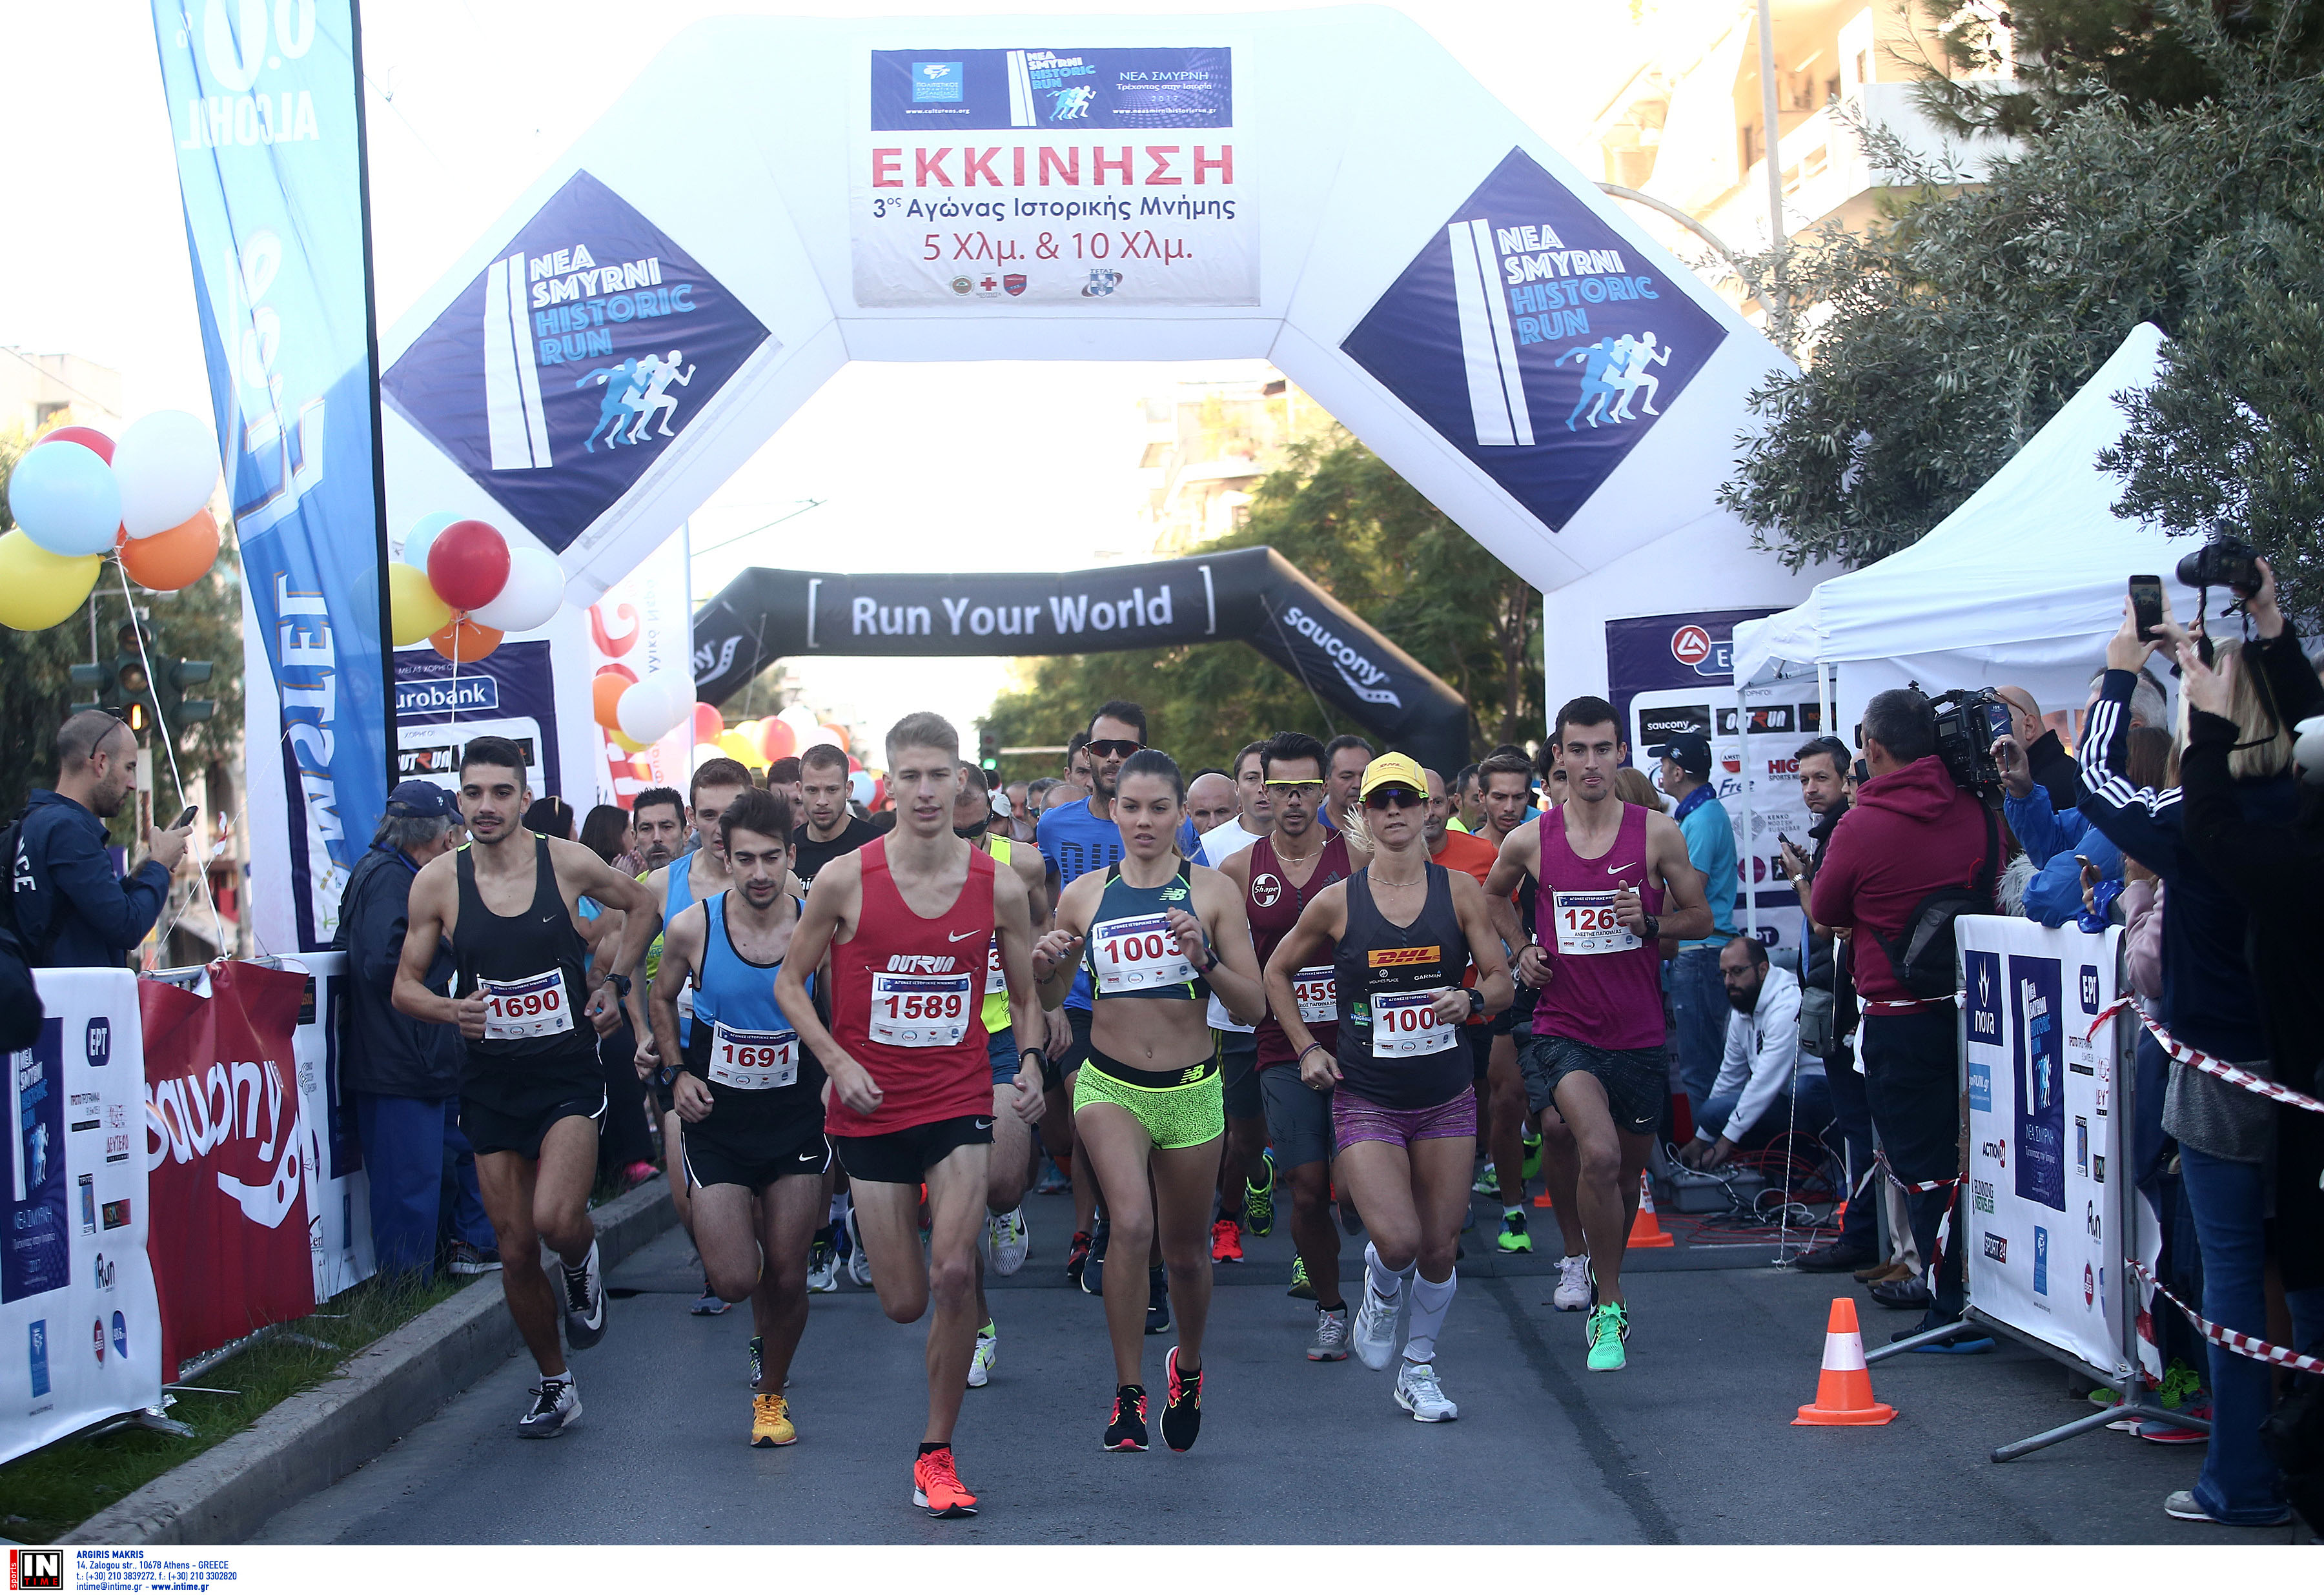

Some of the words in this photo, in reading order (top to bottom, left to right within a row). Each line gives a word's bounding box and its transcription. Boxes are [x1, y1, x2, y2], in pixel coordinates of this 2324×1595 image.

[1027, 51, 1056, 61] NEA
[1028, 57, 1083, 70] SMYRNI
[1030, 65, 1096, 79] HISTORIC
[1033, 78, 1063, 90] RUN
[1120, 72, 1148, 81] ΝΕΑ
[1152, 72, 1208, 81] ΣΜΥΡΝΗ
[873, 145, 1234, 187] ΕΚΚΙΝΗΣΗ
[907, 196, 1005, 221] Αγώνας
[1015, 195, 1132, 221] Ιστορικής
[1140, 195, 1236, 221] Μνήμης
[923, 234, 941, 261] 5
[953, 231, 1025, 267] Χλμ.
[1035, 232, 1059, 259] &
[1073, 232, 1110, 259] 10
[1121, 230, 1193, 266] Χλμ.
[1496, 224, 1565, 256] NEA
[530, 243, 596, 282] NEA
[1504, 249, 1626, 285] SMYRNI
[533, 257, 662, 309] SMYRNI
[1509, 276, 1659, 316] HISTORIC
[535, 284, 697, 338] HISTORIC
[1516, 307, 1590, 345] RUN
[540, 328, 613, 366] RUN
[852, 596, 932, 636] Run
[942, 597, 1041, 636] Your
[1049, 585, 1174, 635] World
[1283, 607, 1385, 685] saucony
[396, 683, 486, 709] urobank
[1647, 720, 1690, 731] saucony
[1726, 710, 1786, 731] OTRUN
[398, 750, 451, 772] UTRUN
[1768, 759, 1800, 774] HIG
[1254, 885, 1279, 895] Shape
[1565, 908, 1627, 931] 126
[887, 954, 956, 973] OUTRUN
[1376, 949, 1433, 964] DHL
[1414, 972, 1442, 980] GARMIN
[489, 990, 560, 1017] 1690
[884, 995, 962, 1019] 1589
[1383, 1008, 1446, 1033] 100
[1975, 1010, 1995, 1035] nova
[90, 1028, 108, 1056] ΕΡΤ
[20, 1048, 34, 1071] NEA
[722, 1044, 789, 1068] 1691
[1984, 1235, 2000, 1257] SPORT
